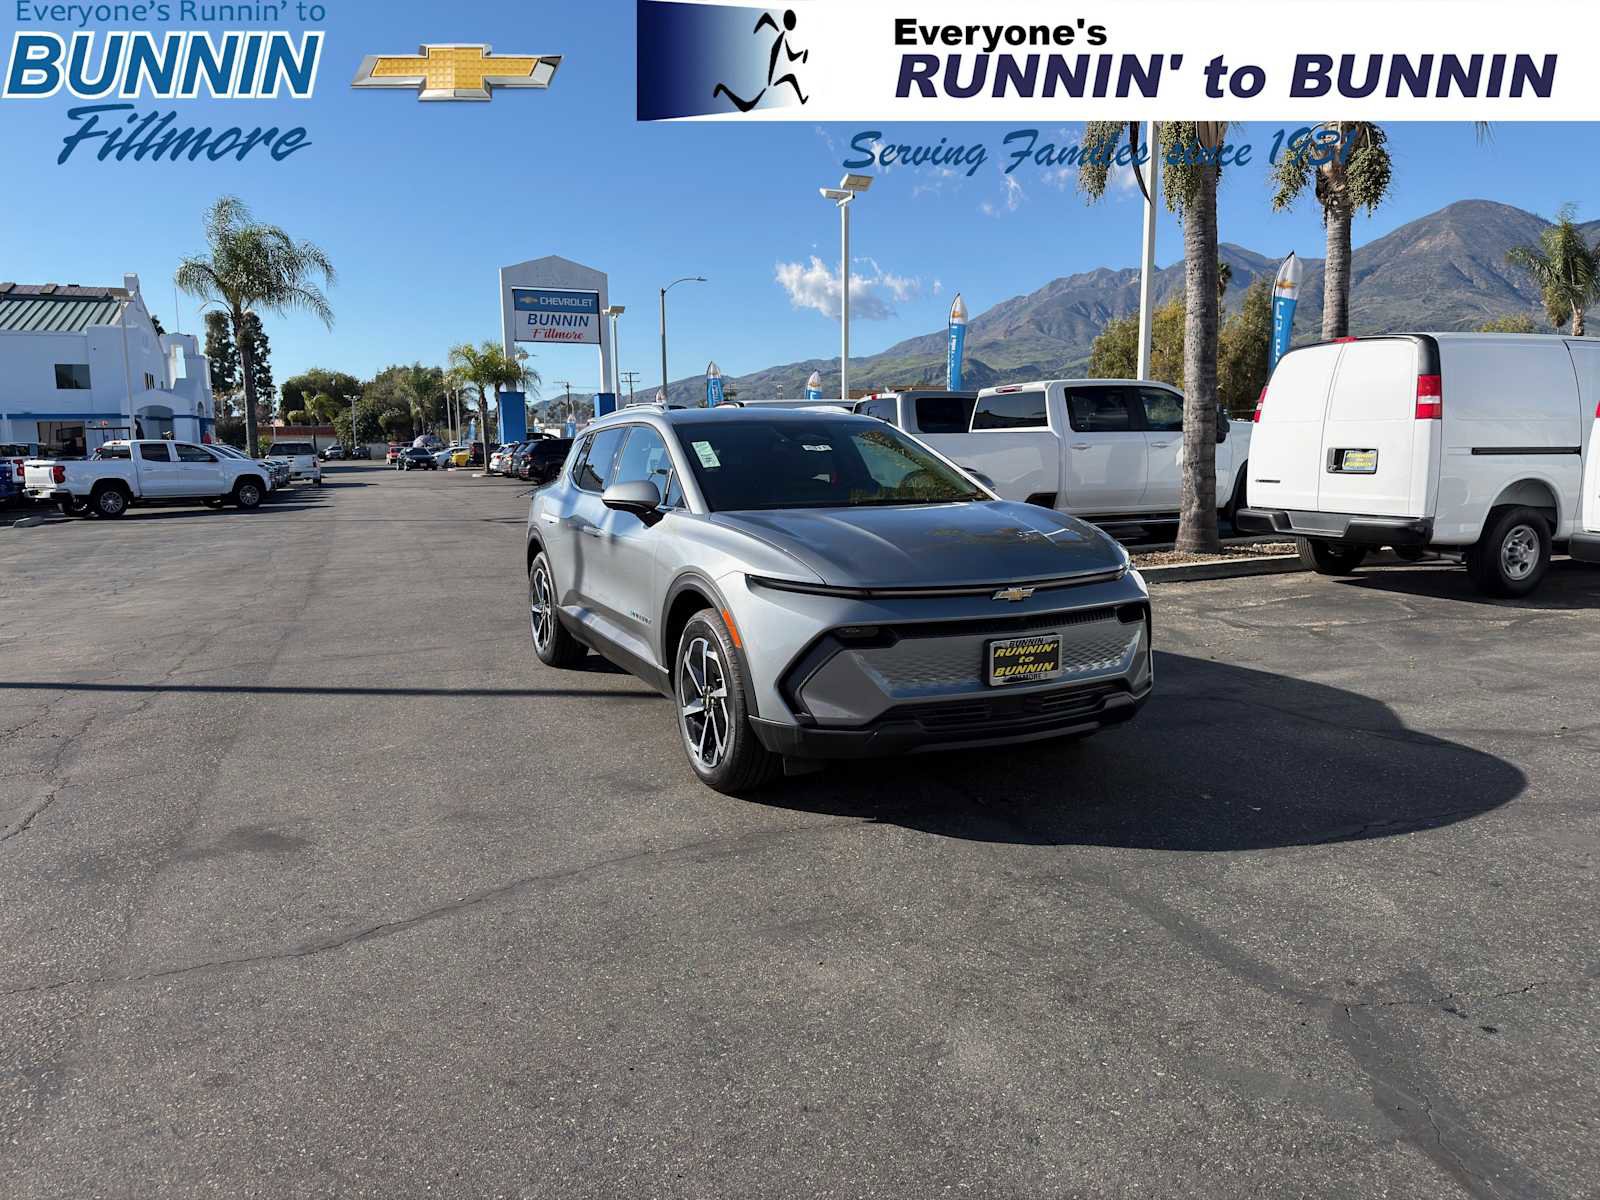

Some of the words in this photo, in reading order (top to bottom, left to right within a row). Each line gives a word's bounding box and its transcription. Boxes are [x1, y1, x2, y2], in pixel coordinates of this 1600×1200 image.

[540, 297, 592, 307] CHEVROLET
[528, 314, 589, 327] BUNNIN
[531, 328, 584, 339] Fillmore
[995, 644, 1058, 657] RUNNIN'
[994, 662, 1054, 676] BUNNIN
